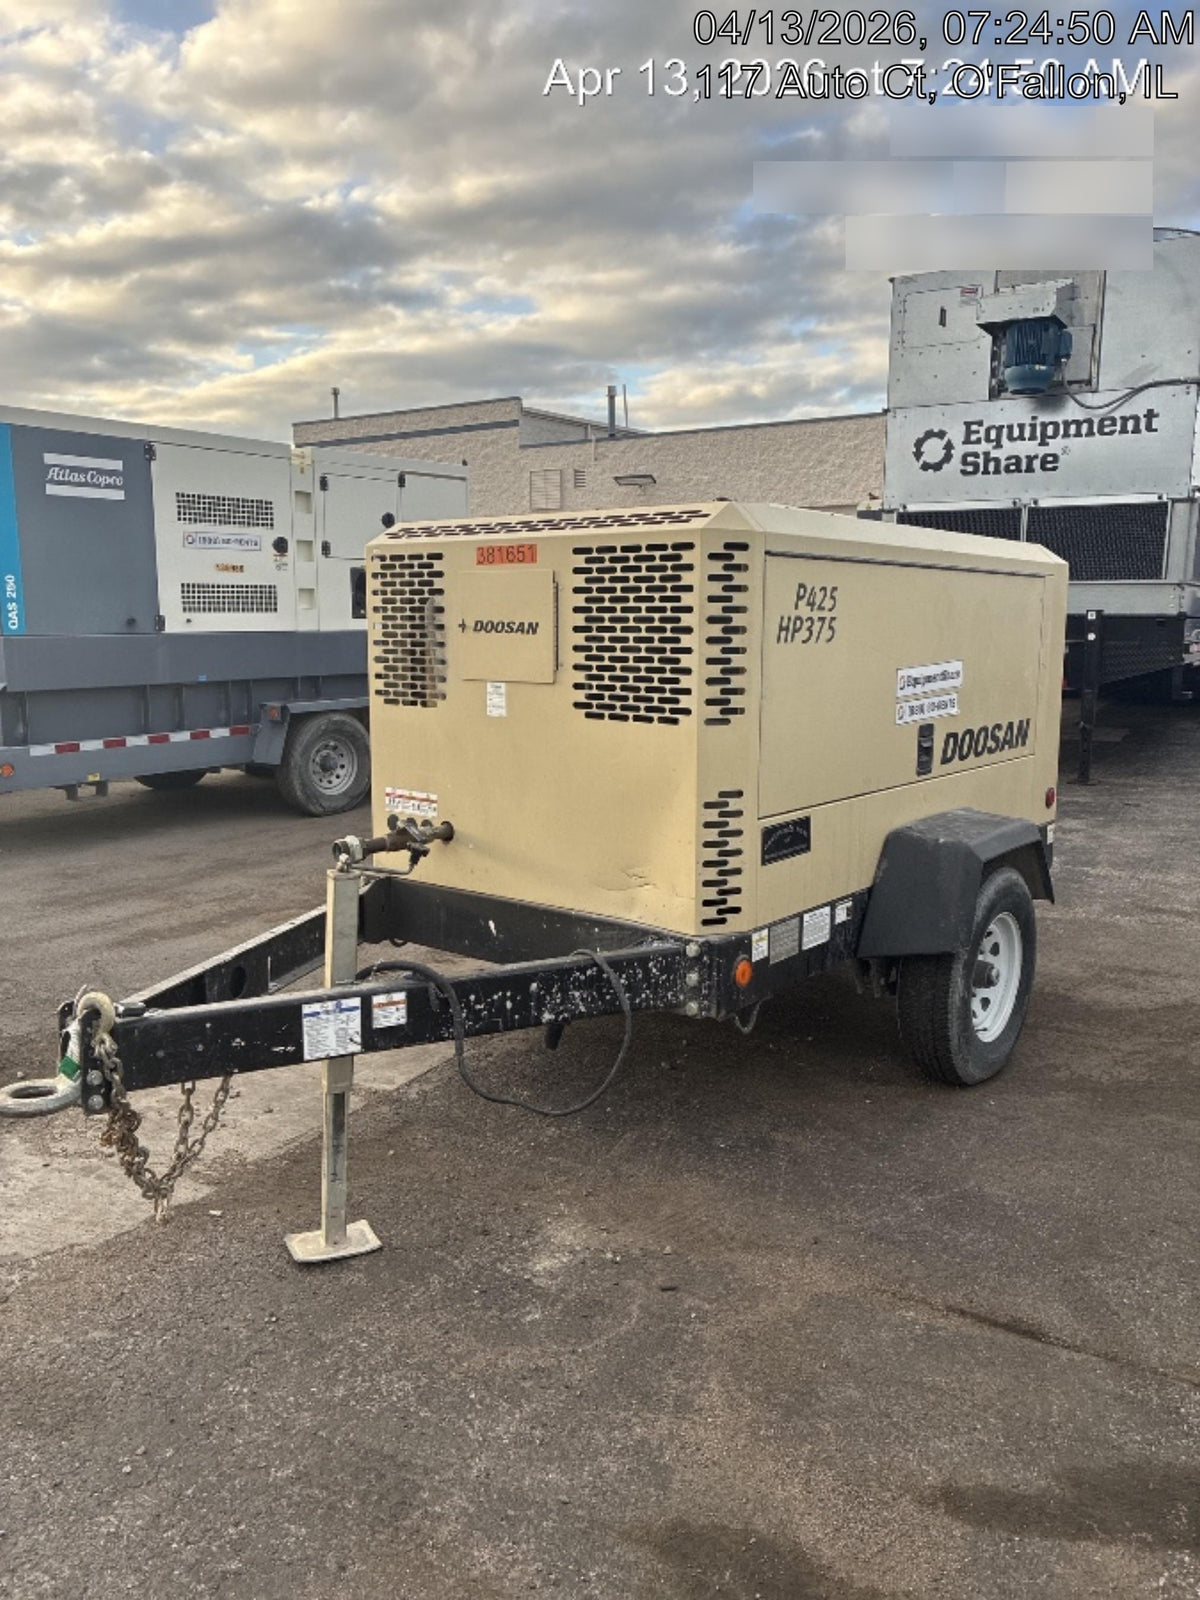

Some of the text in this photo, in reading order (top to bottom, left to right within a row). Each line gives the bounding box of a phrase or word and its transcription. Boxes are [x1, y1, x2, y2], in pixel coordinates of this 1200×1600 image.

[961, 408, 1159, 450] Equipment
[46, 467, 124, 488] Atlas Copco
[959, 451, 1060, 477] Share
[477, 544, 537, 566] 381651
[794, 582, 838, 612] P425
[7, 602, 19, 630] QAS
[473, 619, 539, 635] DOOSAN
[776, 615, 836, 644] HP375
[940, 718, 1031, 765] DOOSAN
